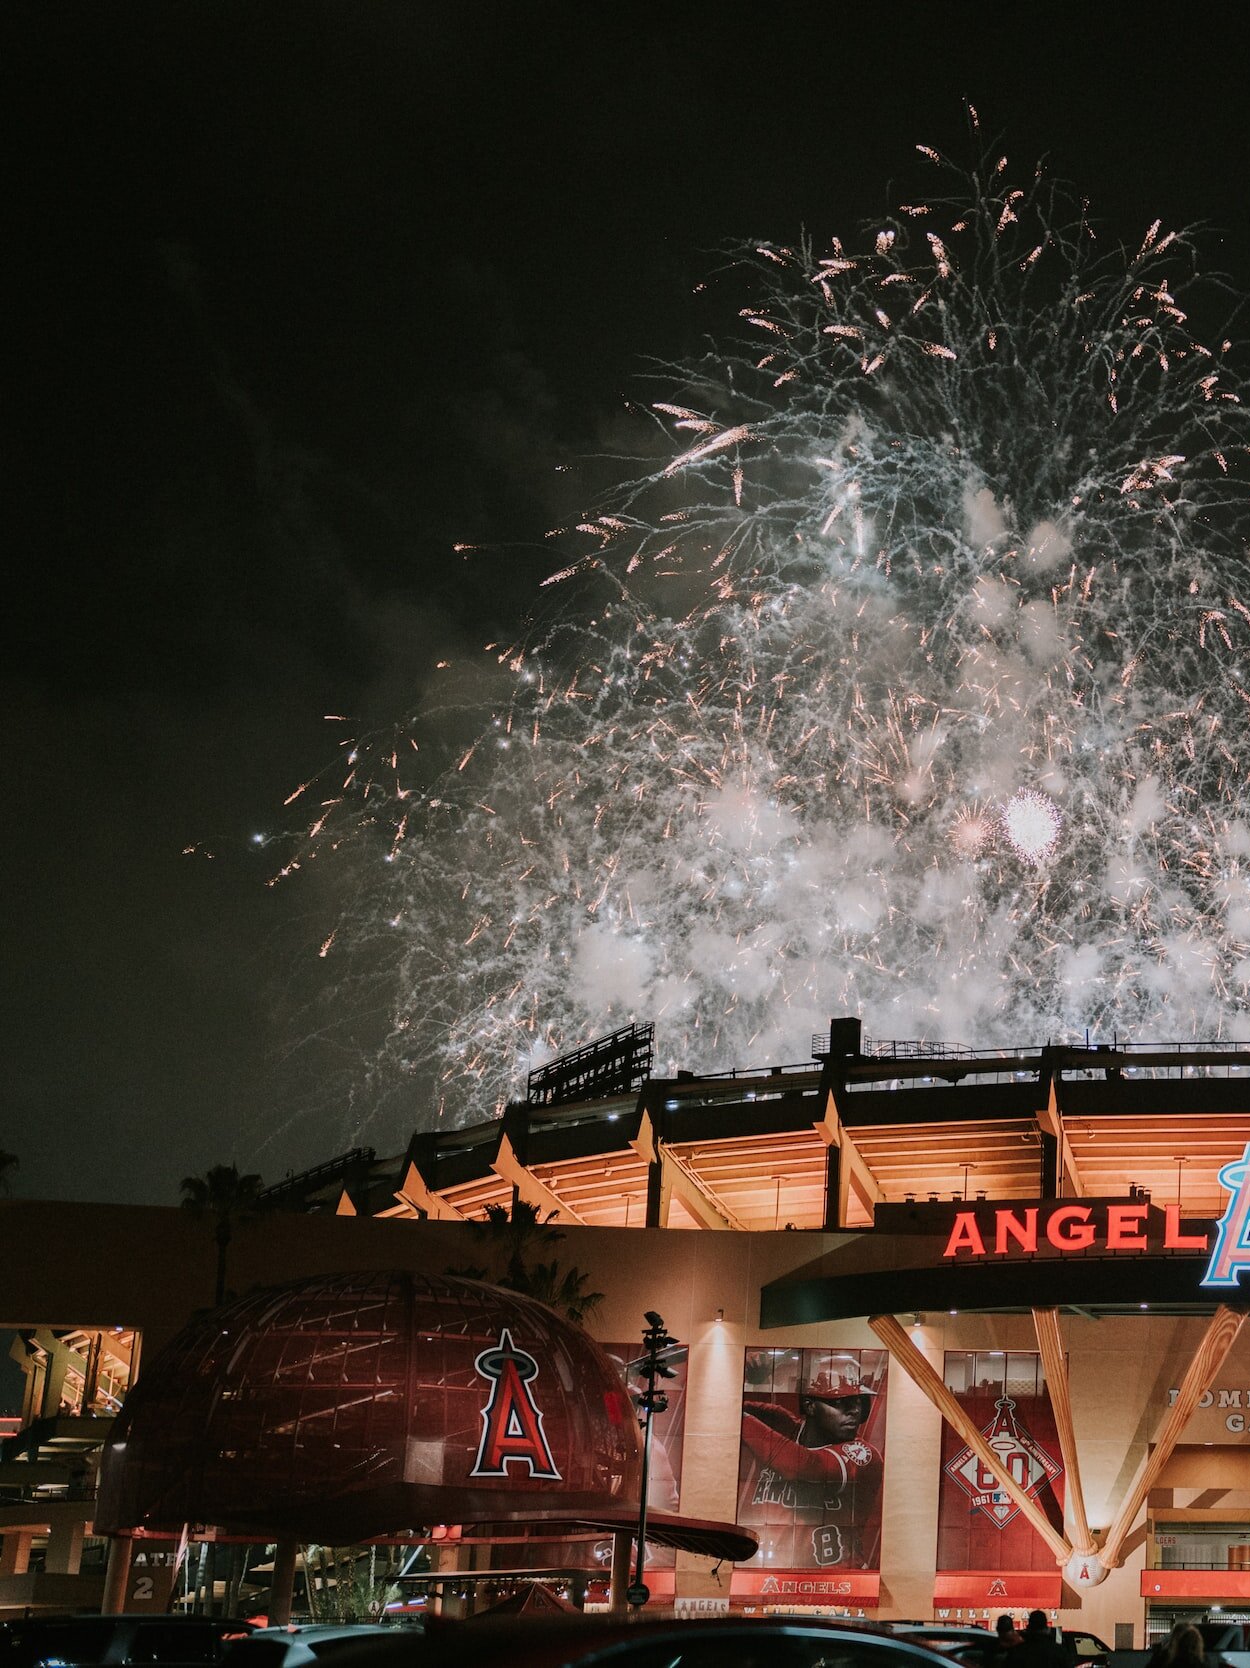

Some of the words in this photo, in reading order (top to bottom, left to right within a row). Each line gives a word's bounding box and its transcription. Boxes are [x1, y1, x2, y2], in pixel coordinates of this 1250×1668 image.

[943, 1203, 1209, 1257] ANGEL
[469, 1328, 563, 1480] A
[991, 1393, 1019, 1439] A
[971, 1494, 990, 1507] 1961
[811, 1524, 844, 1566] 8
[133, 1576, 154, 1600] 2
[760, 1575, 851, 1595] ANGELS
[938, 1609, 990, 1619] WILL
[1006, 1610, 1058, 1619] CAL
